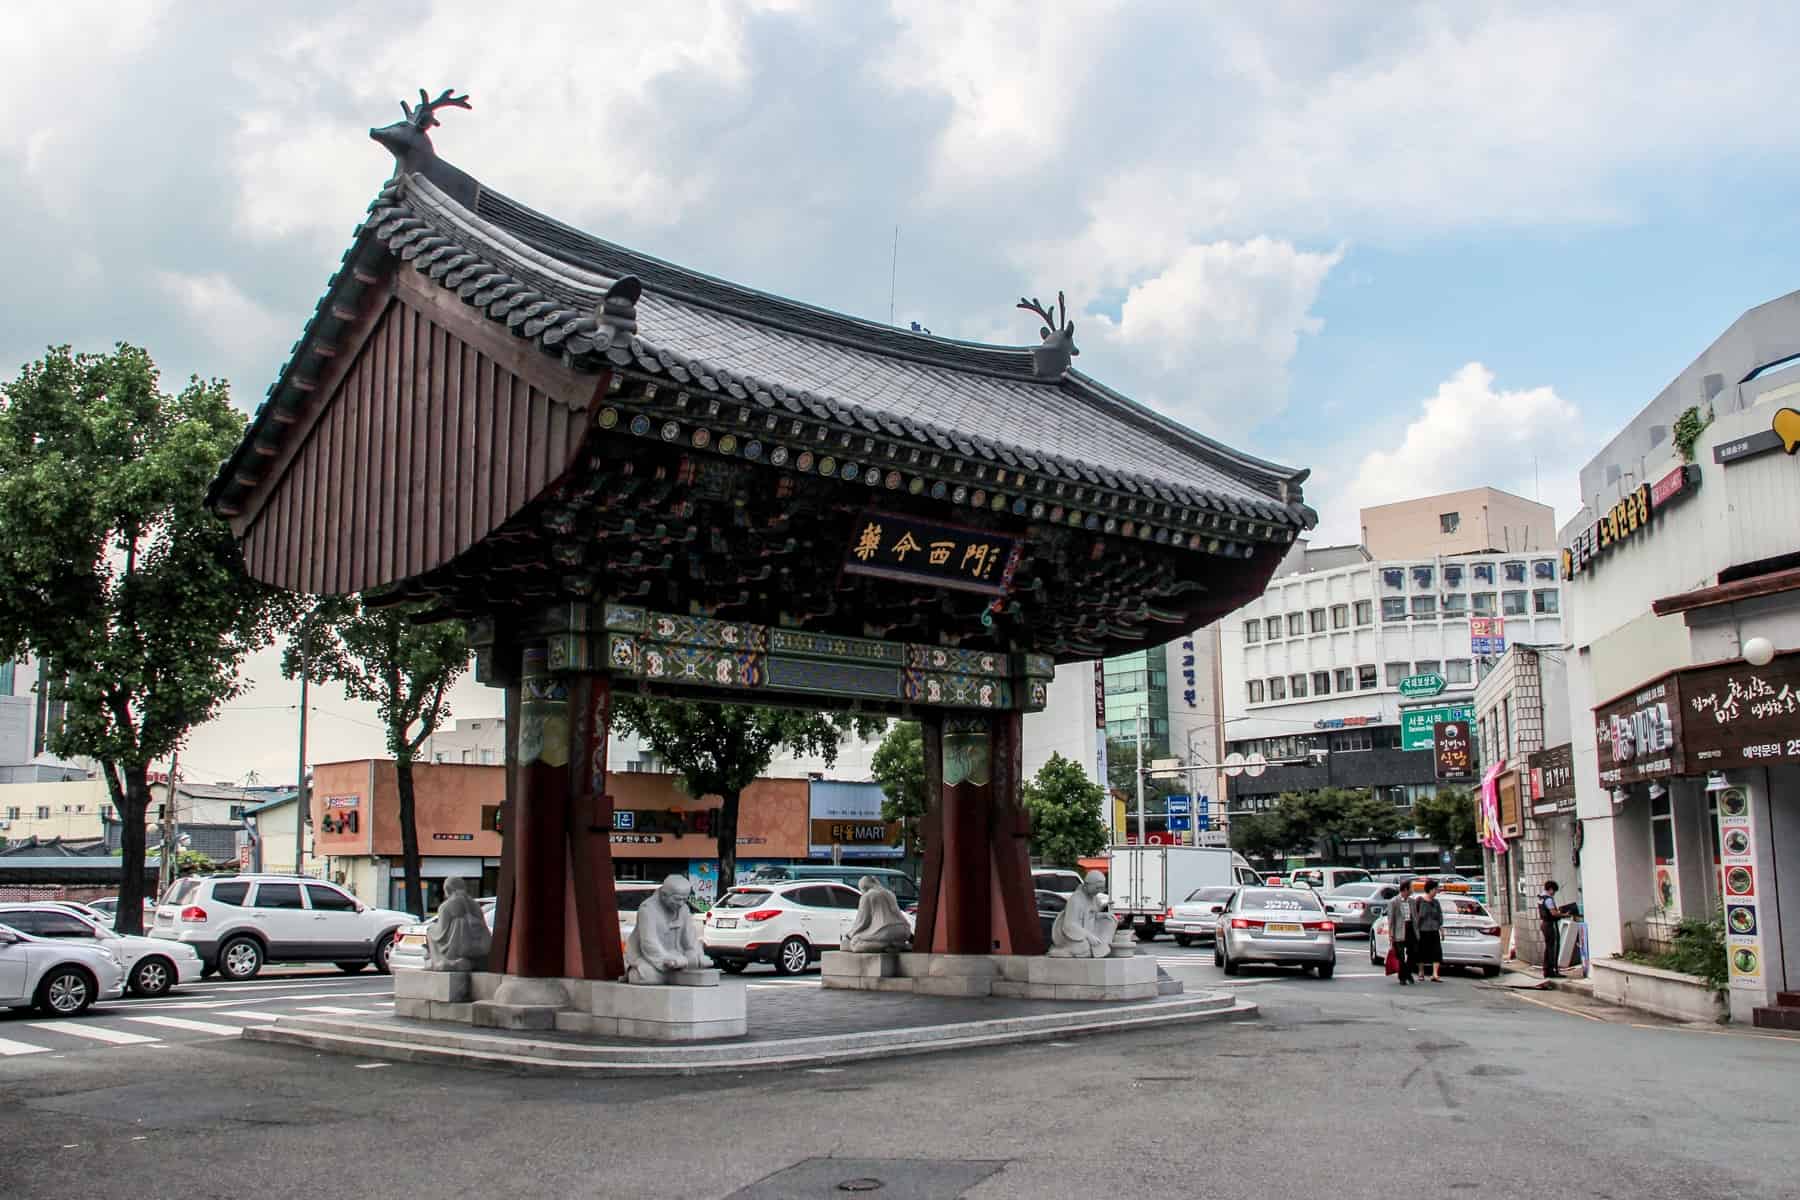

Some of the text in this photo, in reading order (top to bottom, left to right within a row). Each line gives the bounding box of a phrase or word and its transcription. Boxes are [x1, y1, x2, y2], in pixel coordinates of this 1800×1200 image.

[1600, 486, 1649, 546] 노래연습장
[1715, 693, 1740, 723] 미소
[1441, 752, 1467, 766] 식당
[1743, 743, 1781, 758] 예약문의
